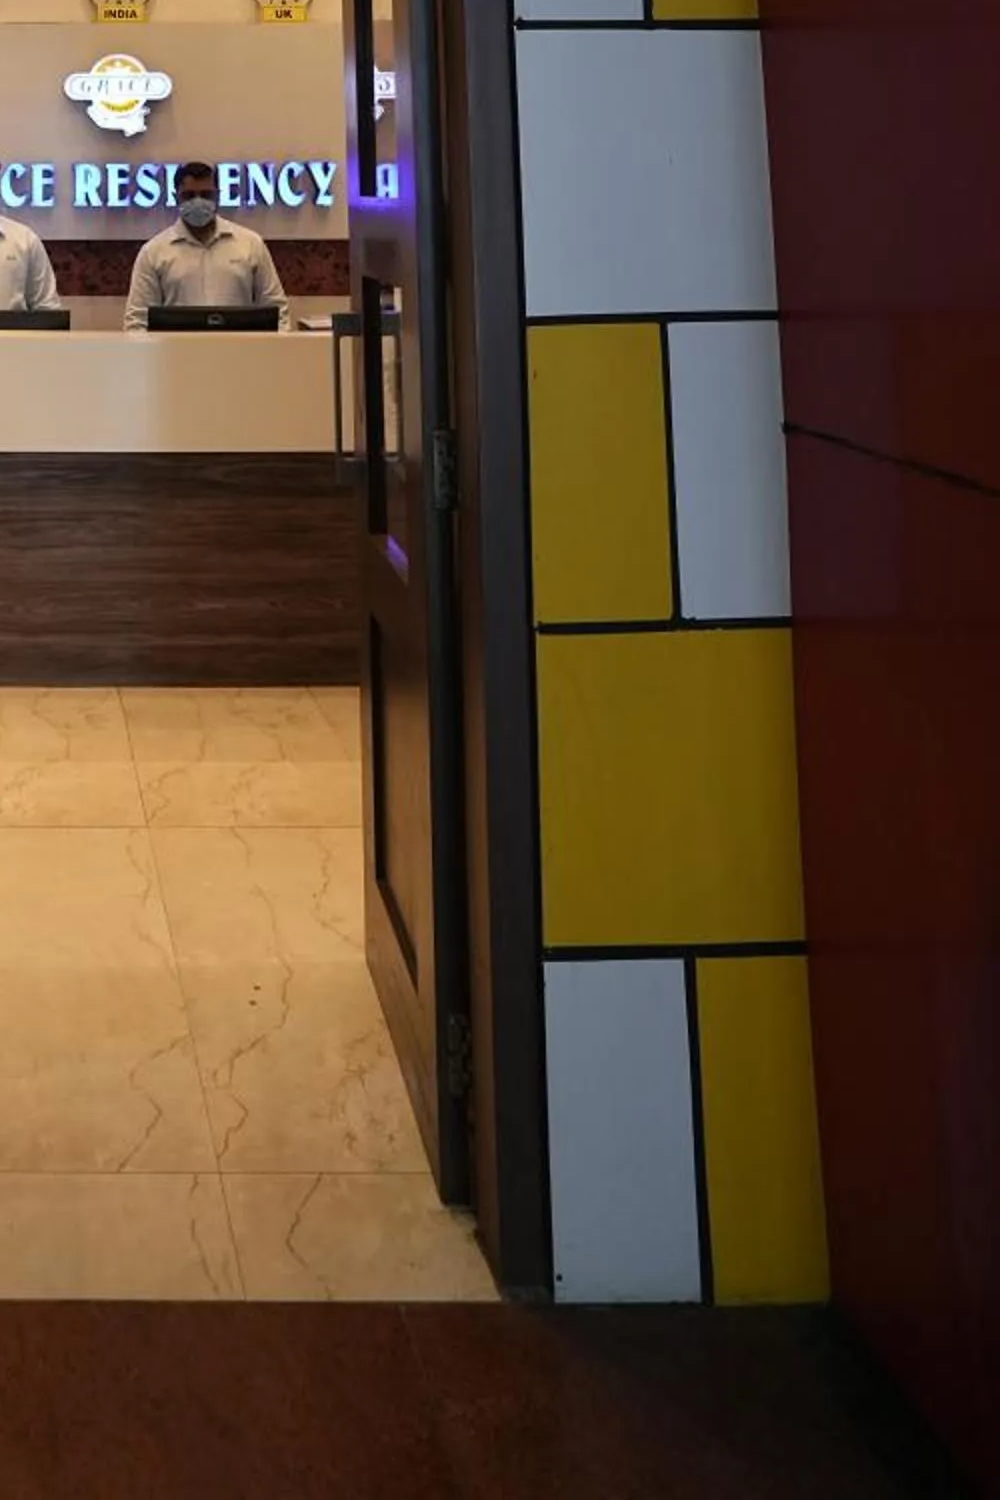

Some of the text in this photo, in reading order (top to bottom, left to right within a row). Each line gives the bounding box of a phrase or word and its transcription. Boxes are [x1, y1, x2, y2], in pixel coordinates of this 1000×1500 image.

[103, 8, 138, 19] INDIA
[275, 9, 293, 19] UK
[80, 78, 155, 95] GRCE
[73, 161, 338, 208] RESIENCY
